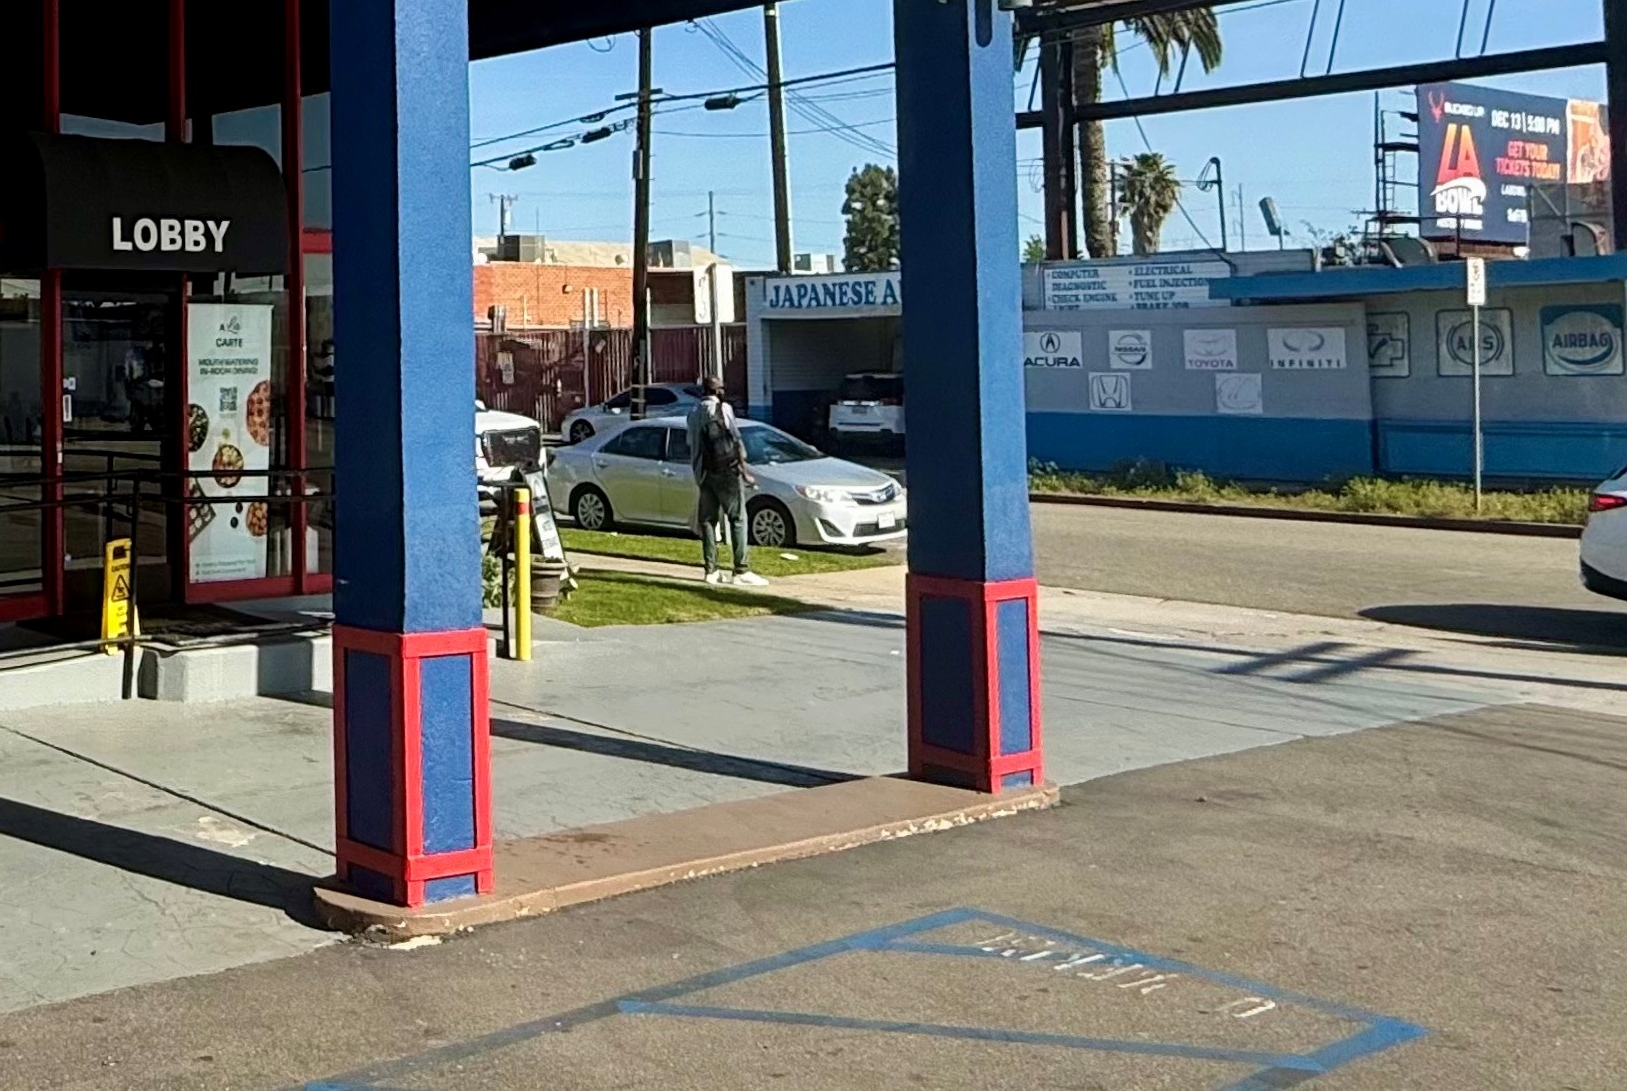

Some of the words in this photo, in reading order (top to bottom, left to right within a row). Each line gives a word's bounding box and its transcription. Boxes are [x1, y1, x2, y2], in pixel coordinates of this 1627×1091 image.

[1491, 110, 1509, 128] DEC
[1511, 112, 1522, 130] 13
[1437, 123, 1480, 182] LA
[1436, 187, 1483, 215] BOWL
[113, 217, 231, 253] LOBBY
[1052, 269, 1100, 279] COMPUTER
[1135, 265, 1193, 276] ELECTRICAL
[1134, 279, 1157, 288] FUEL
[770, 280, 877, 308] JAPANESE
[881, 279, 901, 306] A
[1052, 294, 1080, 304] CHECK
[1134, 291, 1158, 301] TUNE
[1161, 291, 1175, 300] UP
[1553, 333, 1610, 348] AIRBAG
[1024, 356, 1081, 367] ACURA
[1188, 359, 1233, 367] TOYOTA
[1270, 359, 1341, 367] INFINITI
